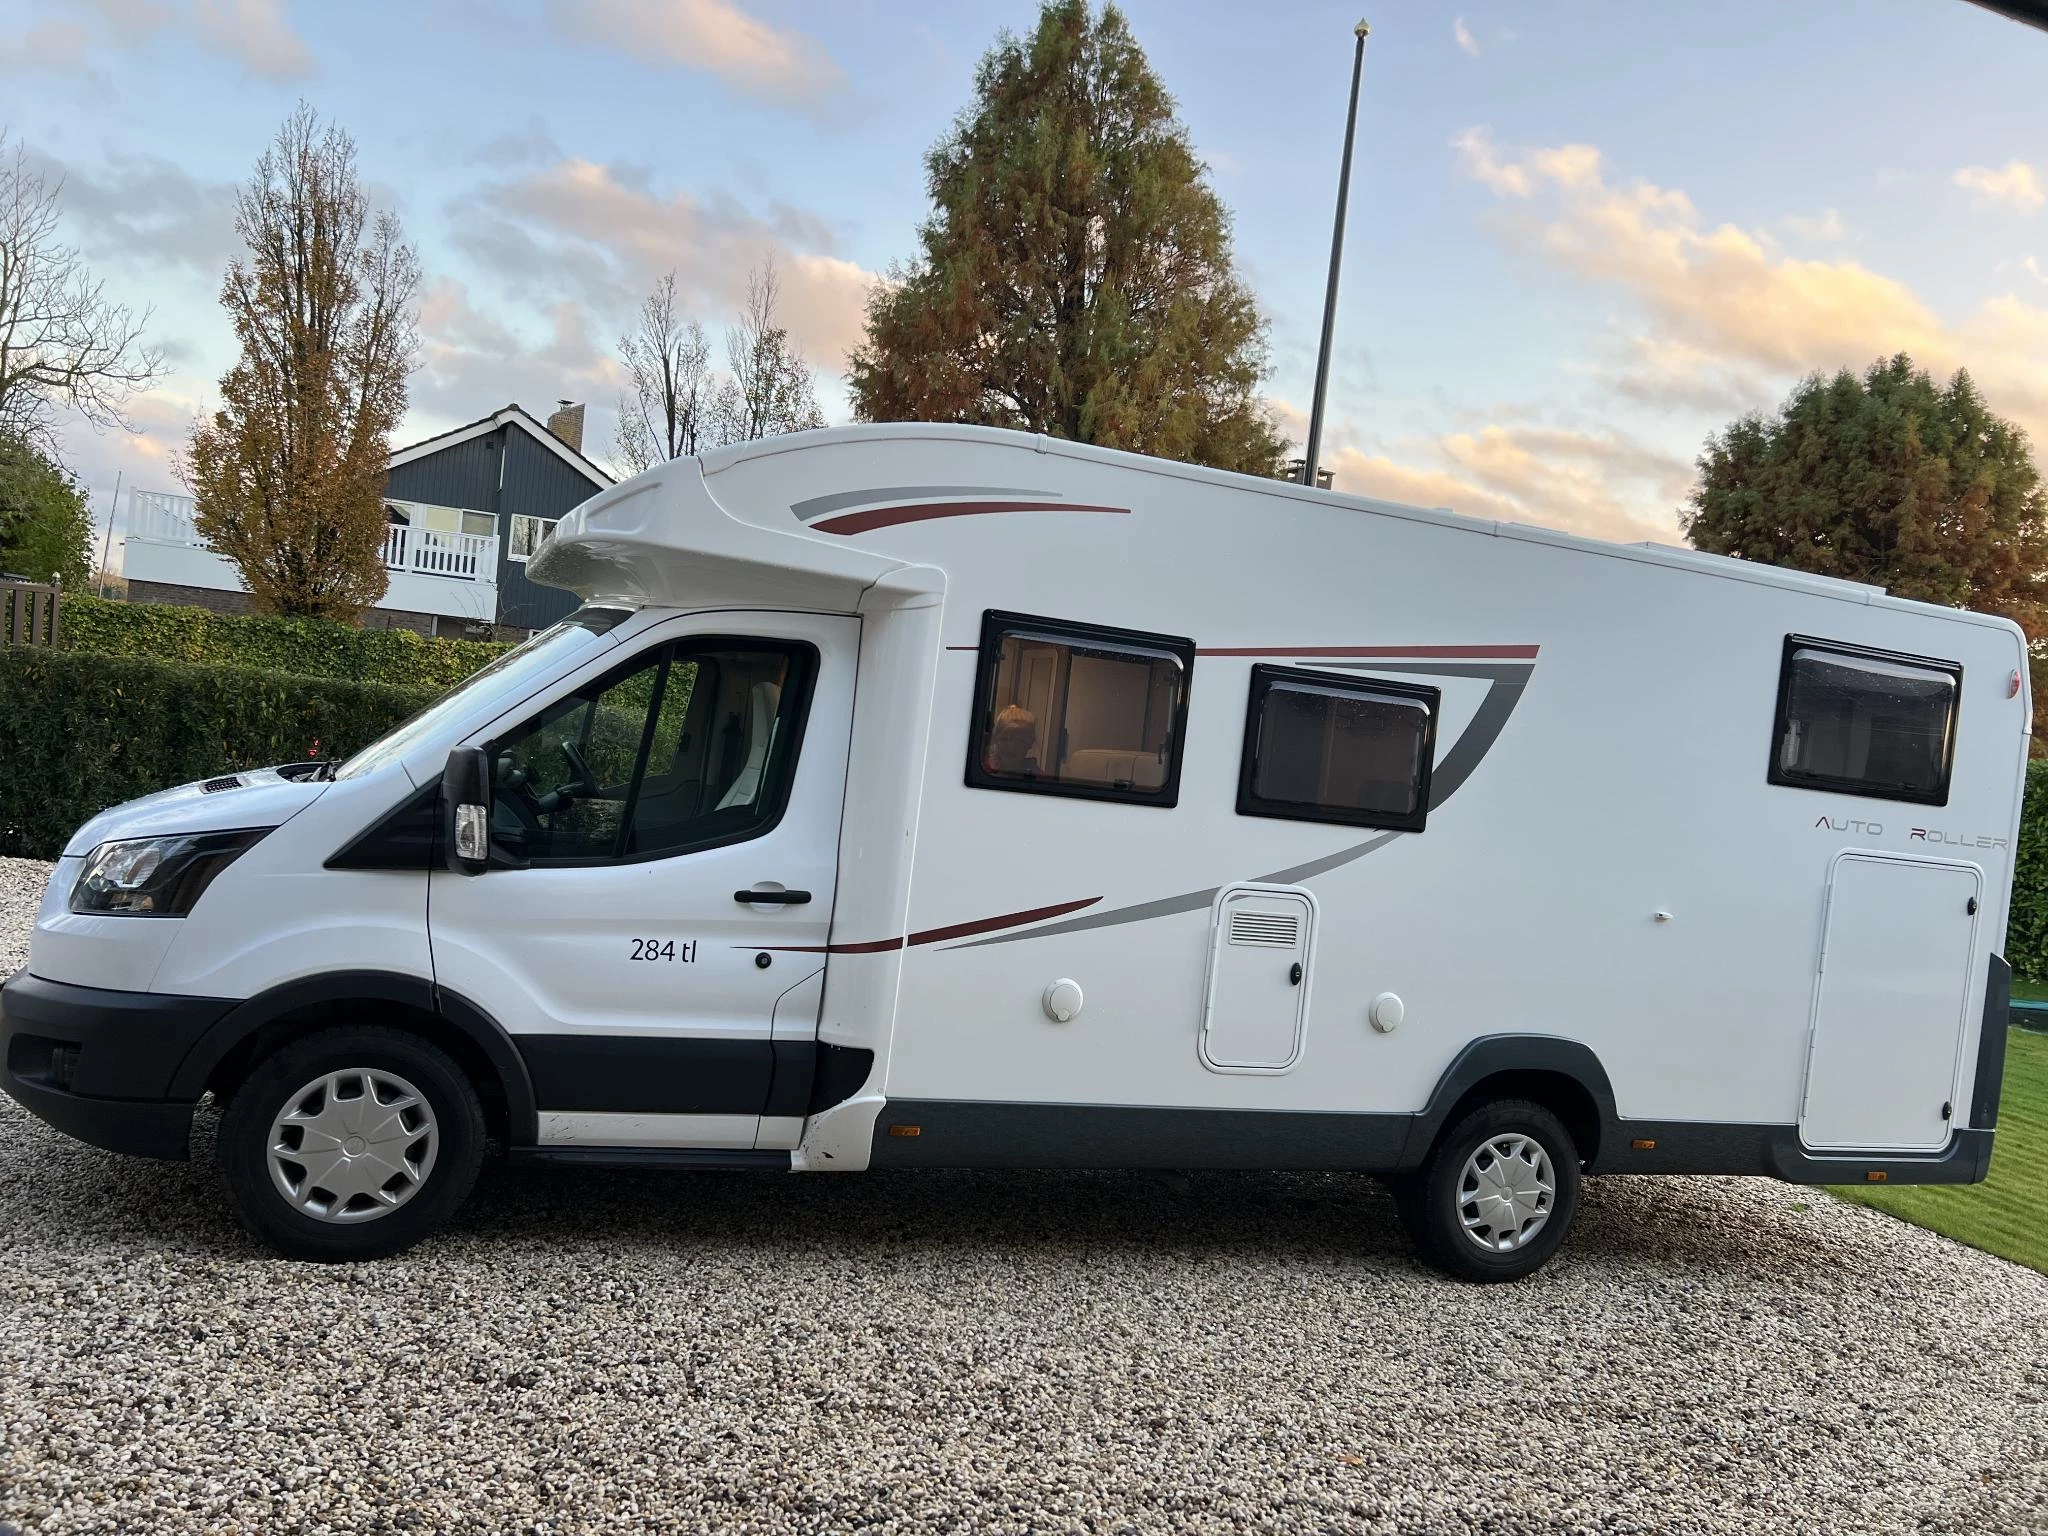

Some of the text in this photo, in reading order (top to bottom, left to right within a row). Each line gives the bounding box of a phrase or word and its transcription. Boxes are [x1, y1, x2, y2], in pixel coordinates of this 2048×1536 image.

[1815, 816, 2008, 850] AUTO ROLLER
[630, 938, 697, 963] 284 tl
